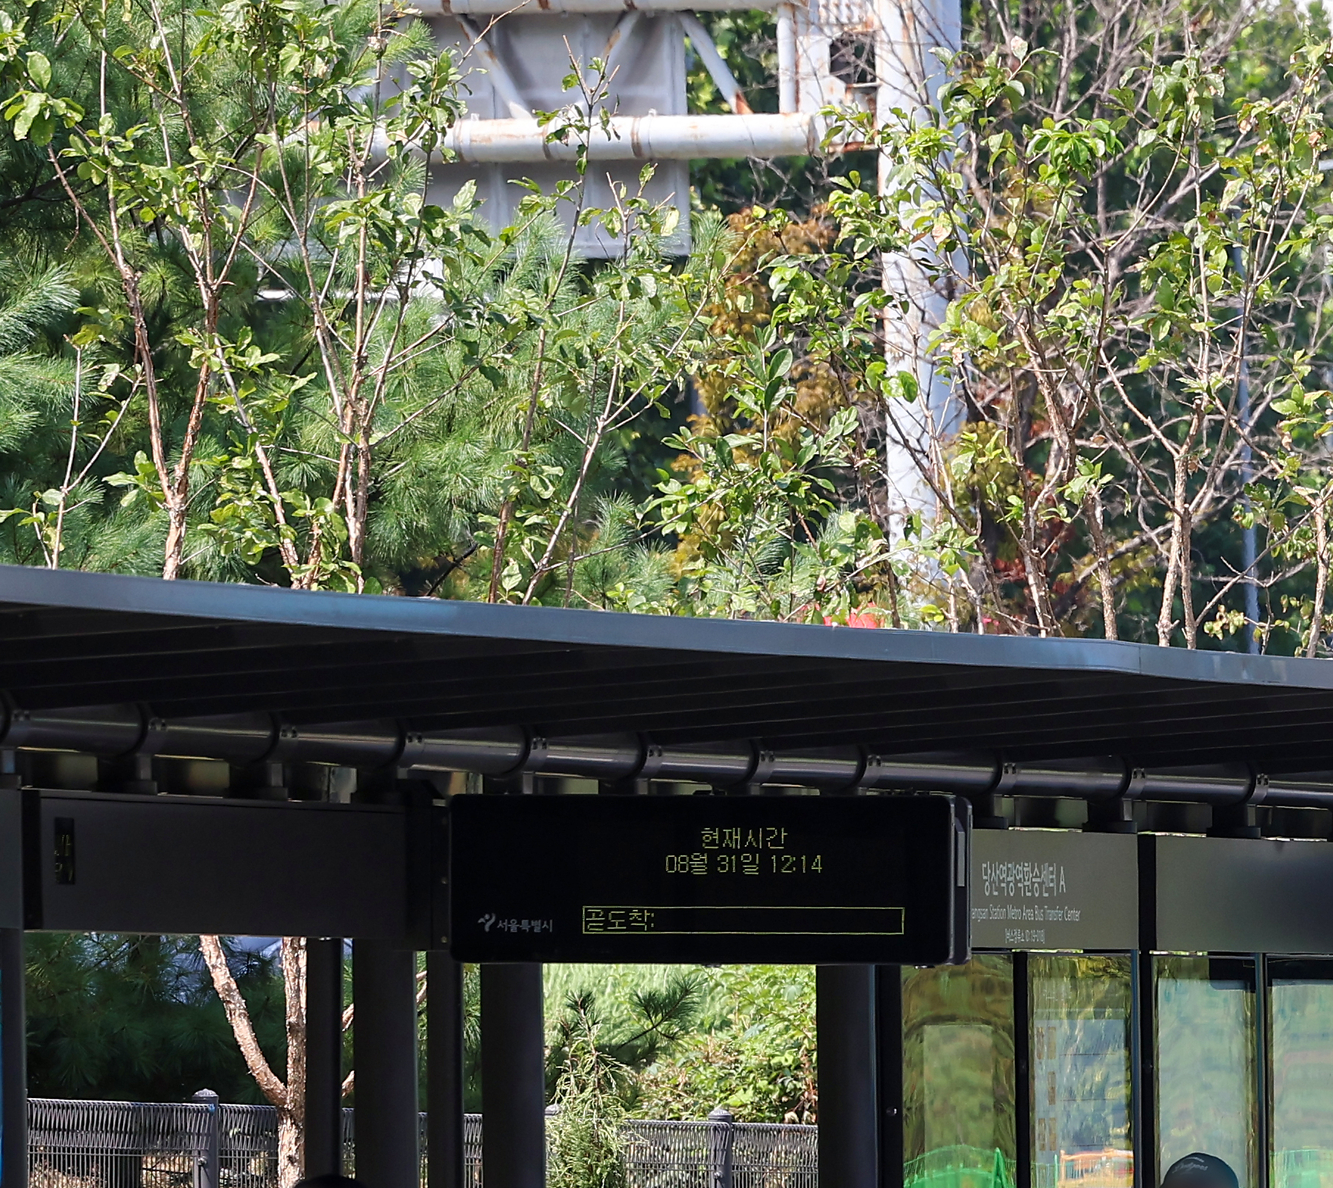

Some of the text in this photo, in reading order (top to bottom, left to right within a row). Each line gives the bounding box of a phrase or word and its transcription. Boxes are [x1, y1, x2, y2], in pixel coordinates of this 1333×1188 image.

[701, 827, 788, 849] 현재시간
[665, 853, 822, 875] 08월 31일 12:14
[982, 861, 1067, 898] 당산역광역환승센터 A
[971, 907, 988, 923] angsan
[989, 904, 1007, 920] Station
[497, 919, 553, 933] 서울특별시
